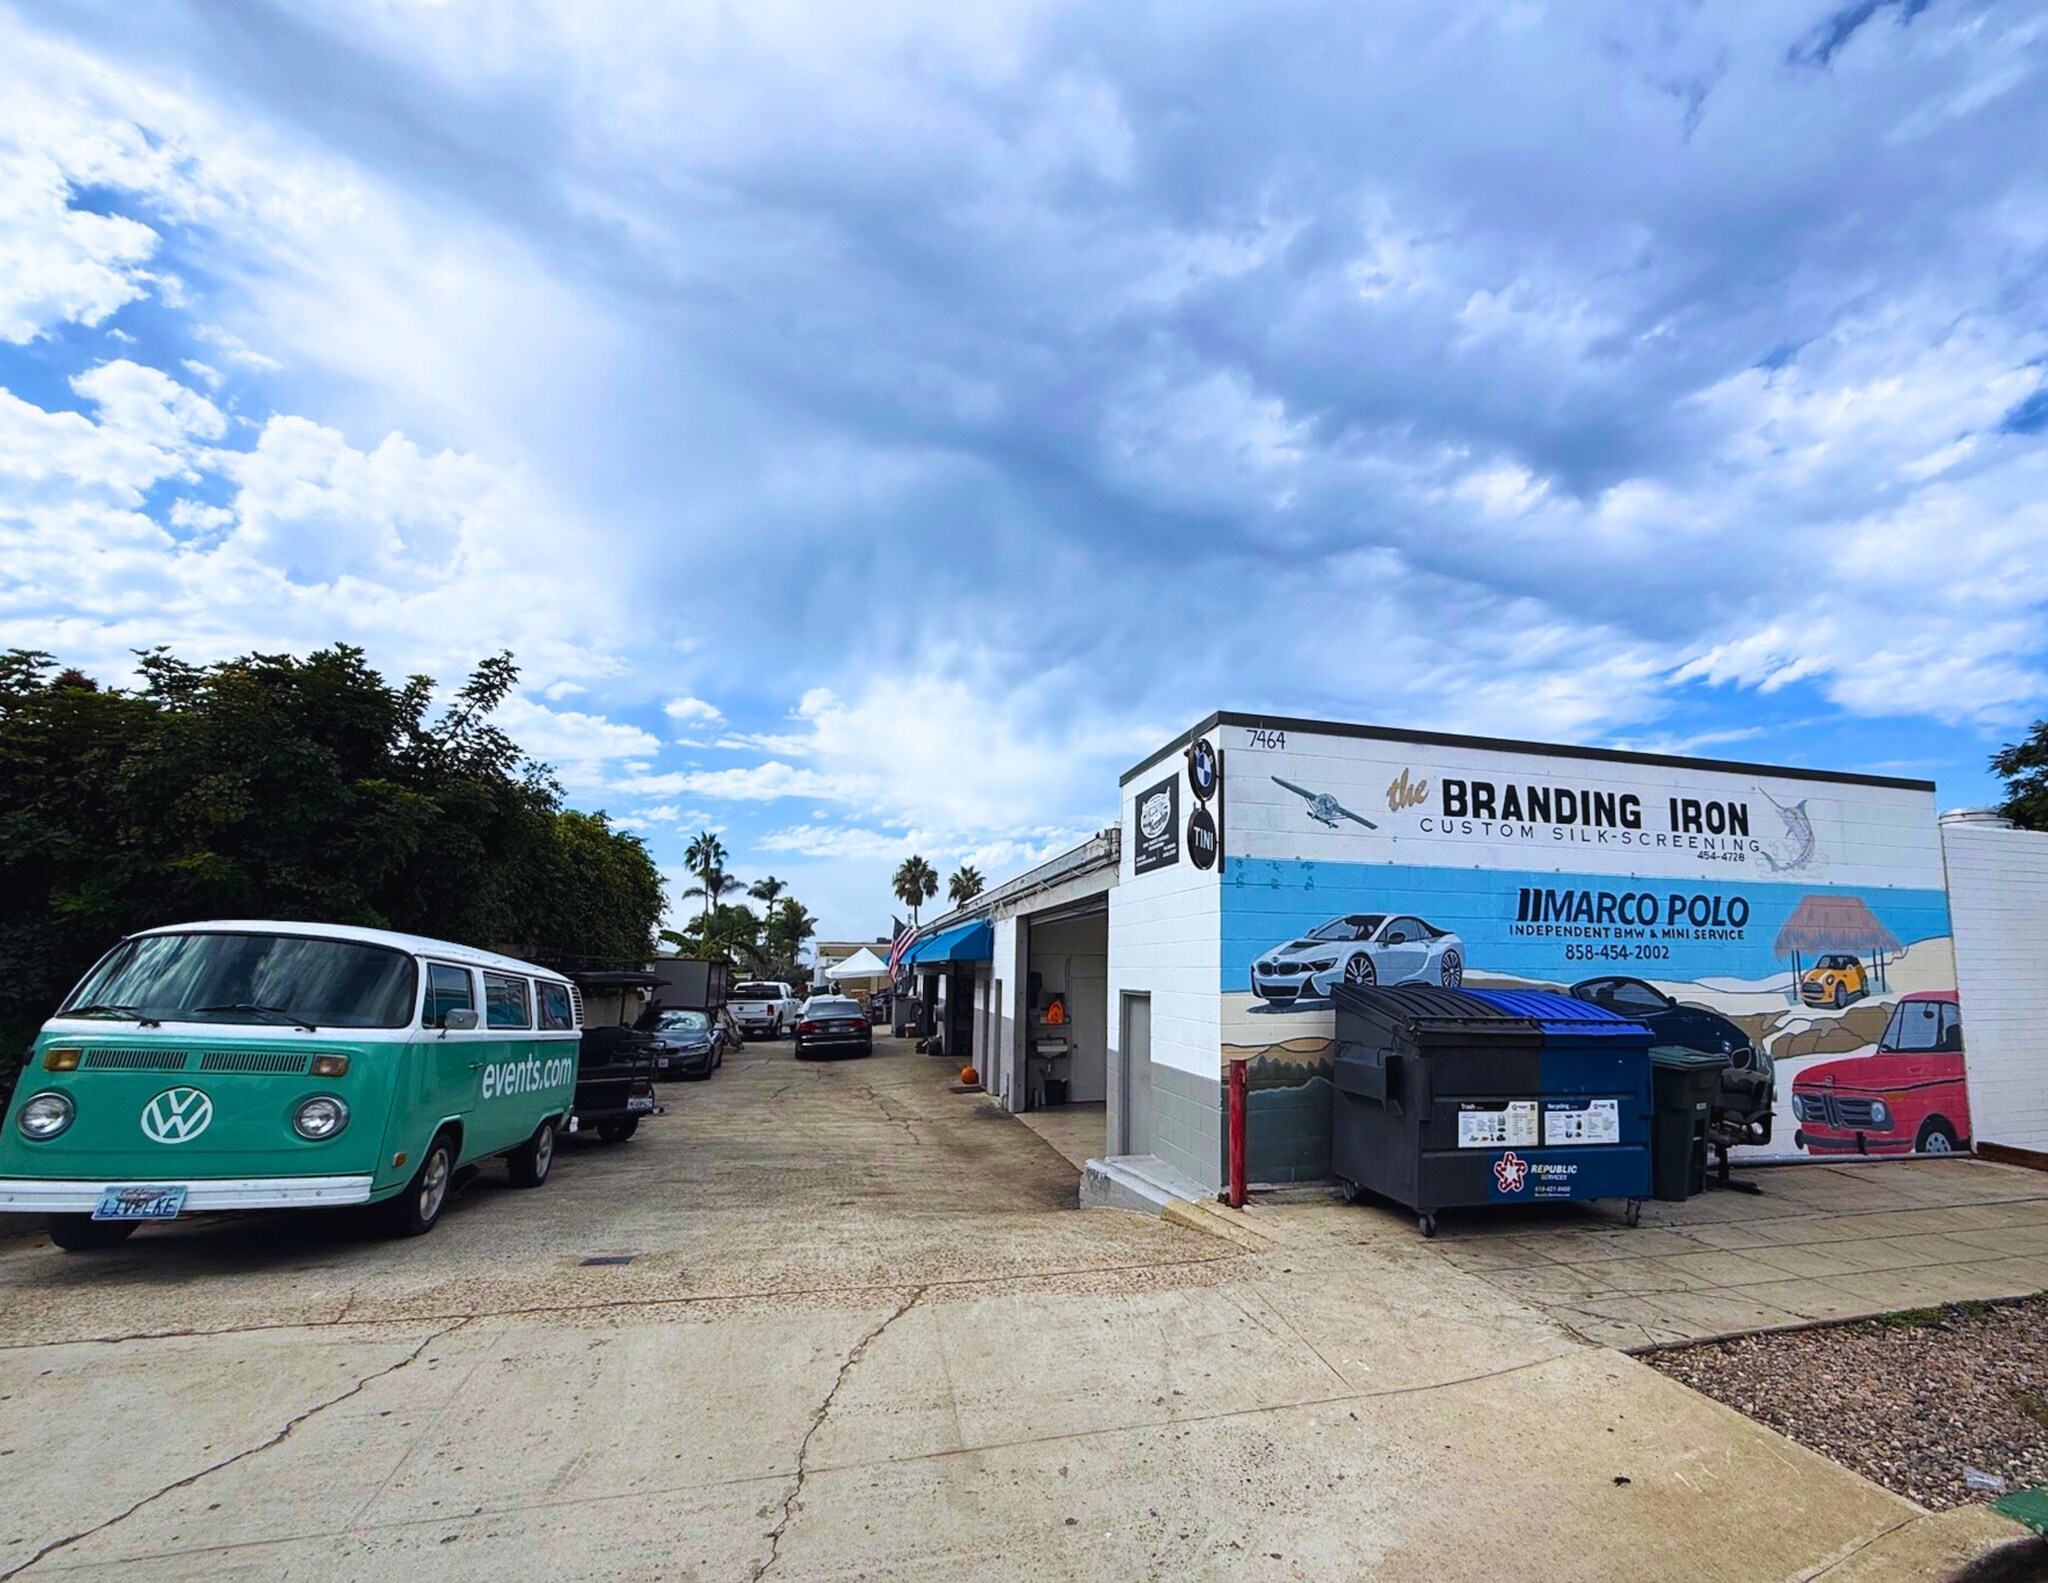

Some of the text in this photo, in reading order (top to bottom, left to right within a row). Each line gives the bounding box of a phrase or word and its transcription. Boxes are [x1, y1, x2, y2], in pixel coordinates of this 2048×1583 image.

[1246, 729, 1286, 750] 7464
[1386, 767, 1429, 812] the
[1442, 778, 1749, 837] BRANDING IRON
[1420, 818, 1760, 853] CUSTOM SILK-SCREENING
[1697, 850, 1745, 863] 454-4728
[1667, 893, 1750, 929] POLO
[1509, 924, 1745, 941] INDEPENDENT BMW & MINI SERVICE
[1565, 943, 1670, 961] 858-454-2002
[482, 1052, 572, 1100] events.com
[1530, 1164, 1578, 1174] REPUBLIC
